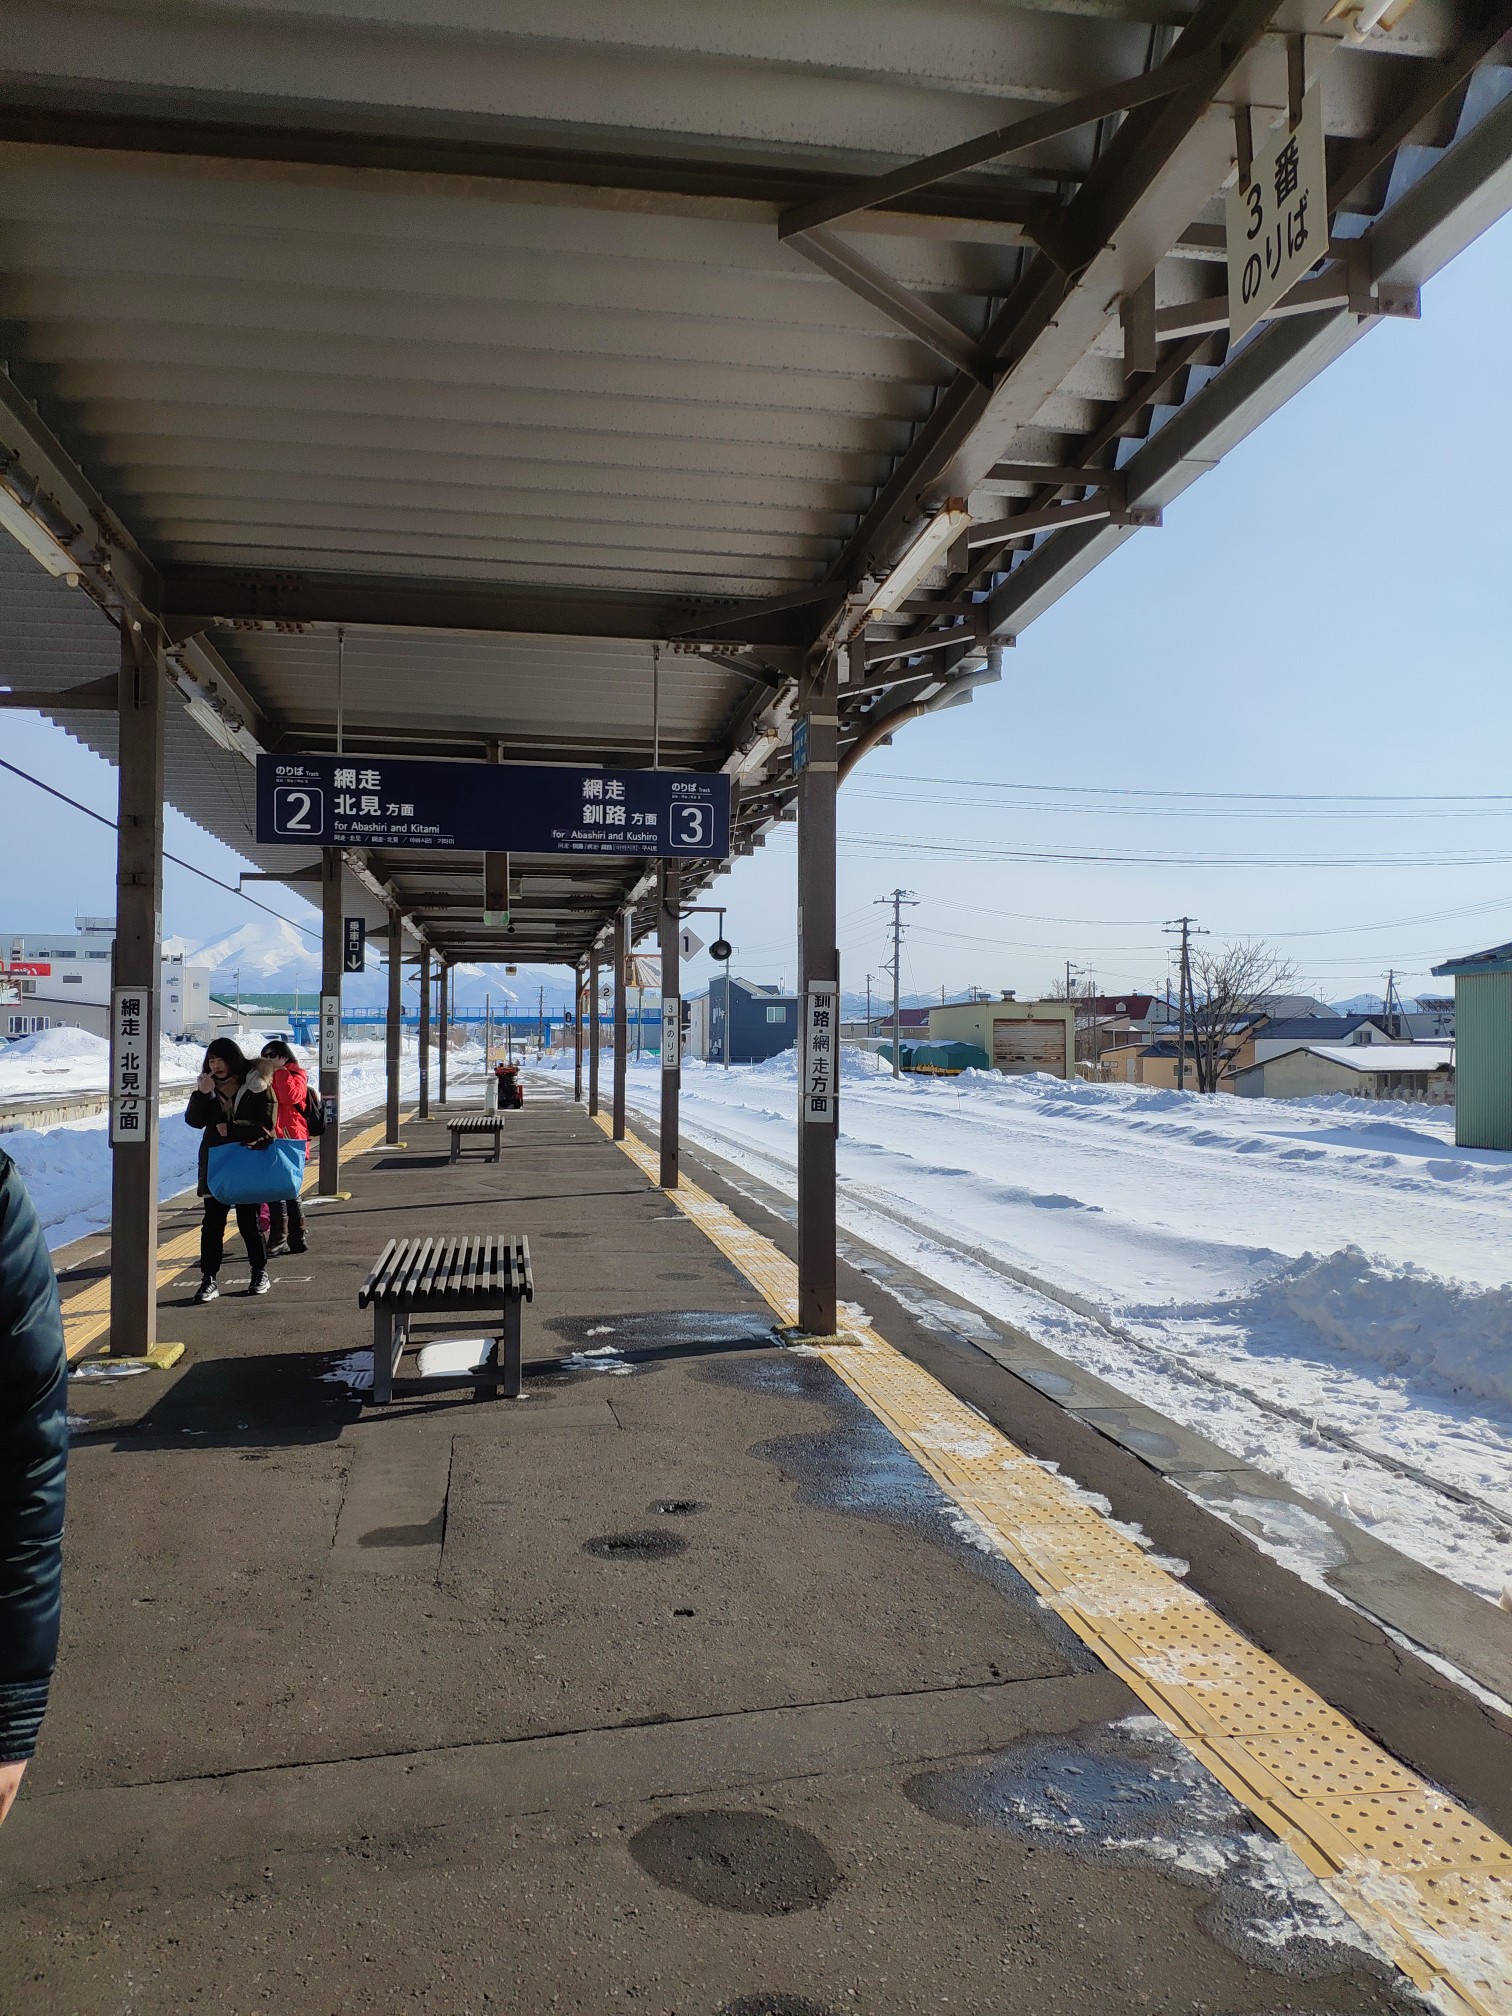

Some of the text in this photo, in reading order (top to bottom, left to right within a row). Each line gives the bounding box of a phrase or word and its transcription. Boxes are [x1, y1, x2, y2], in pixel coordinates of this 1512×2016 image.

[1246, 134, 1301, 241] 3番
[1242, 187, 1310, 305] のりば
[275, 766, 305, 776] のりば
[334, 768, 381, 790] 網走
[582, 778, 626, 800] 網走
[671, 782, 697, 792] のりば
[286, 792, 312, 830] 2
[334, 794, 414, 817] 北見 方面
[582, 803, 658, 826] 釧路 方面
[334, 820, 440, 834] for Abashiri and Kitami
[552, 829, 658, 841] for Abashiri and Kushiro
[680, 807, 703, 843] 3
[349, 920, 361, 951] 乗車口
[683, 935, 690, 952] 1
[603, 987, 610, 997] 2
[325, 1003, 335, 1065] 2番のりば
[666, 1004, 675, 1063] 3番のりば
